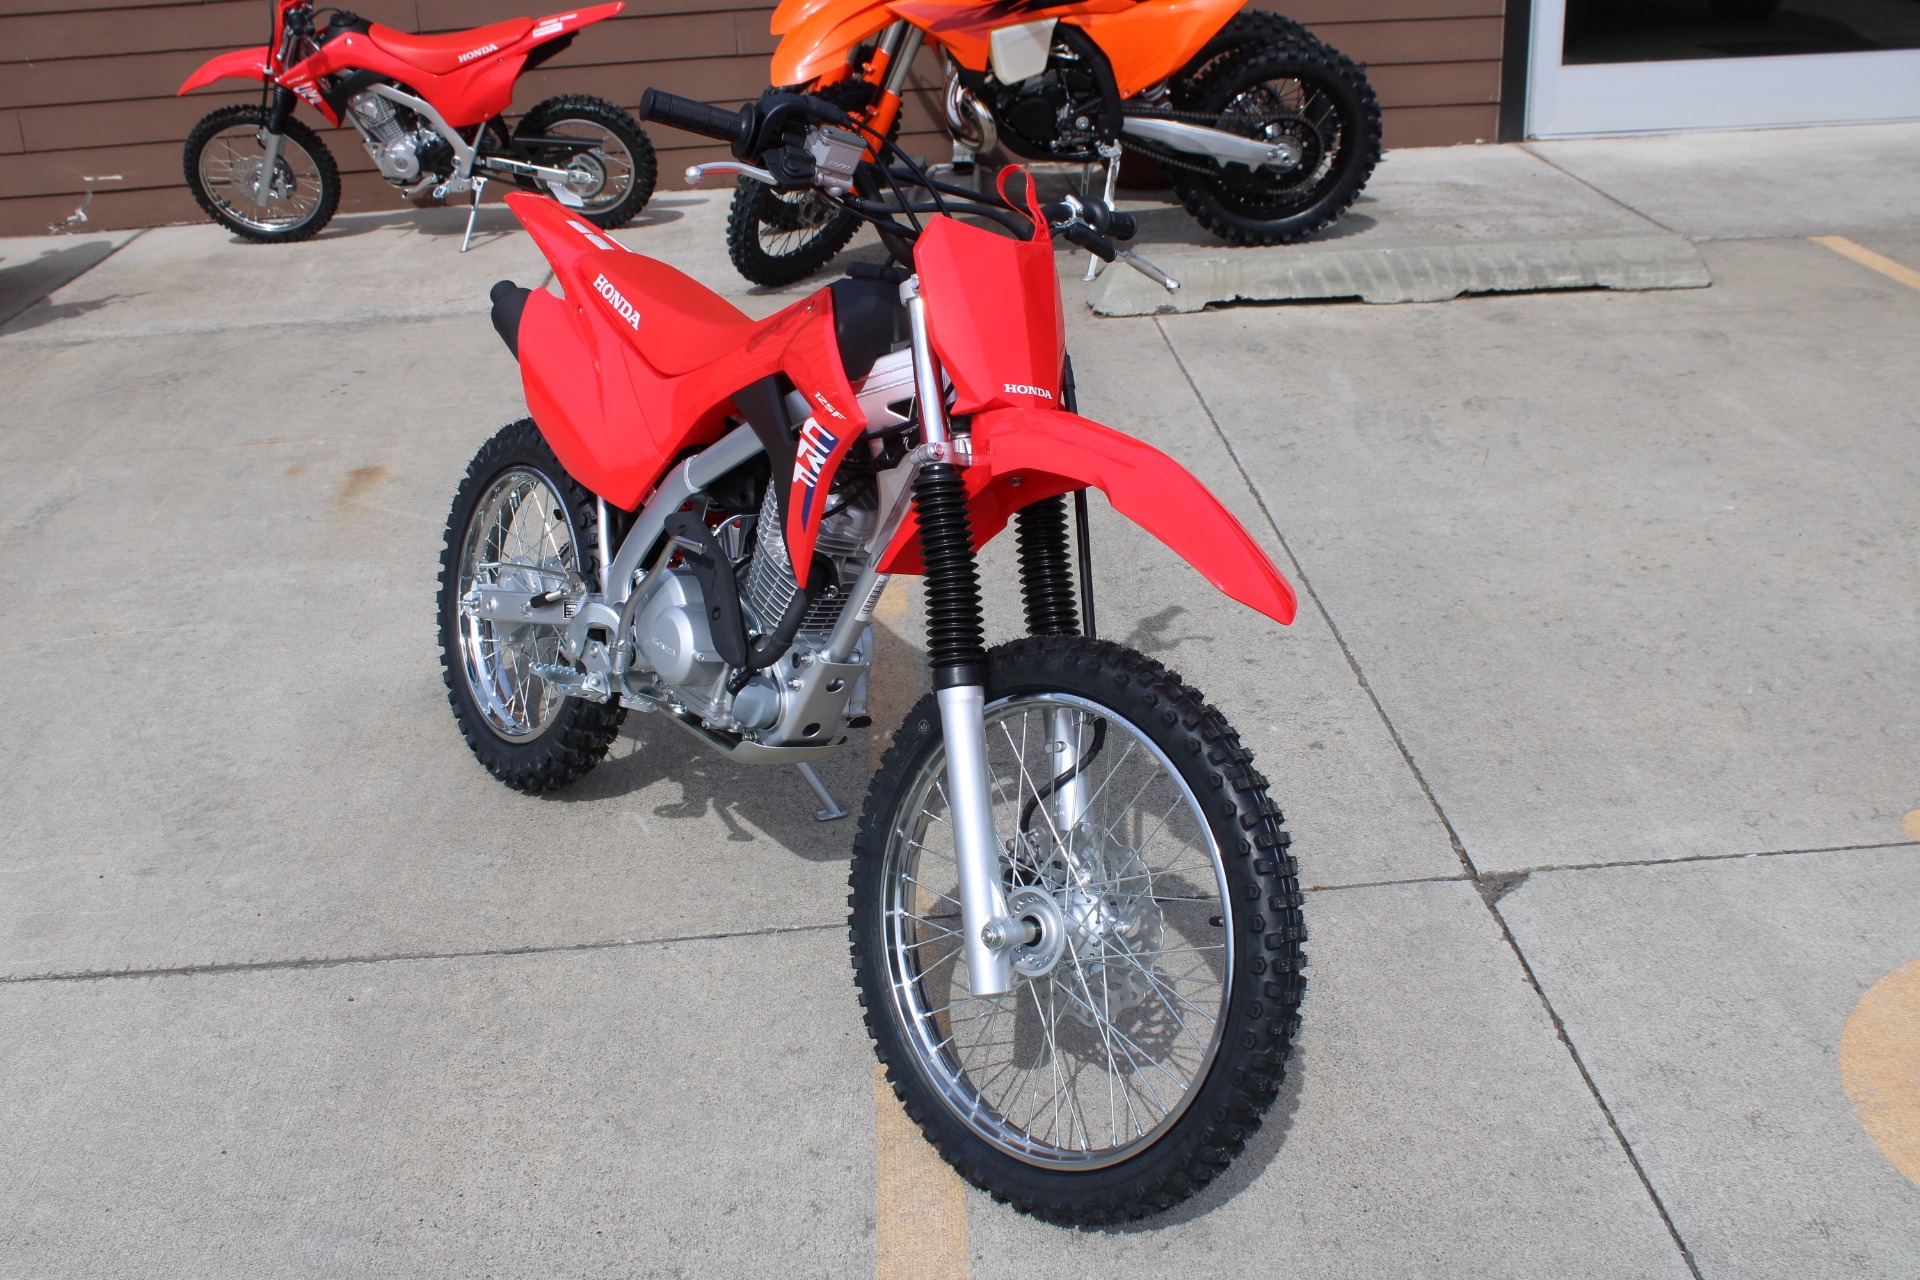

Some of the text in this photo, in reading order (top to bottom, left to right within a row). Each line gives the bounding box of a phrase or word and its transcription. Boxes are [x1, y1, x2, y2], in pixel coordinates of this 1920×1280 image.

[458, 43, 499, 63] HONDA
[592, 273, 641, 331] HONDA
[1003, 383, 1053, 400] HONDA
[814, 391, 847, 420] 125F
